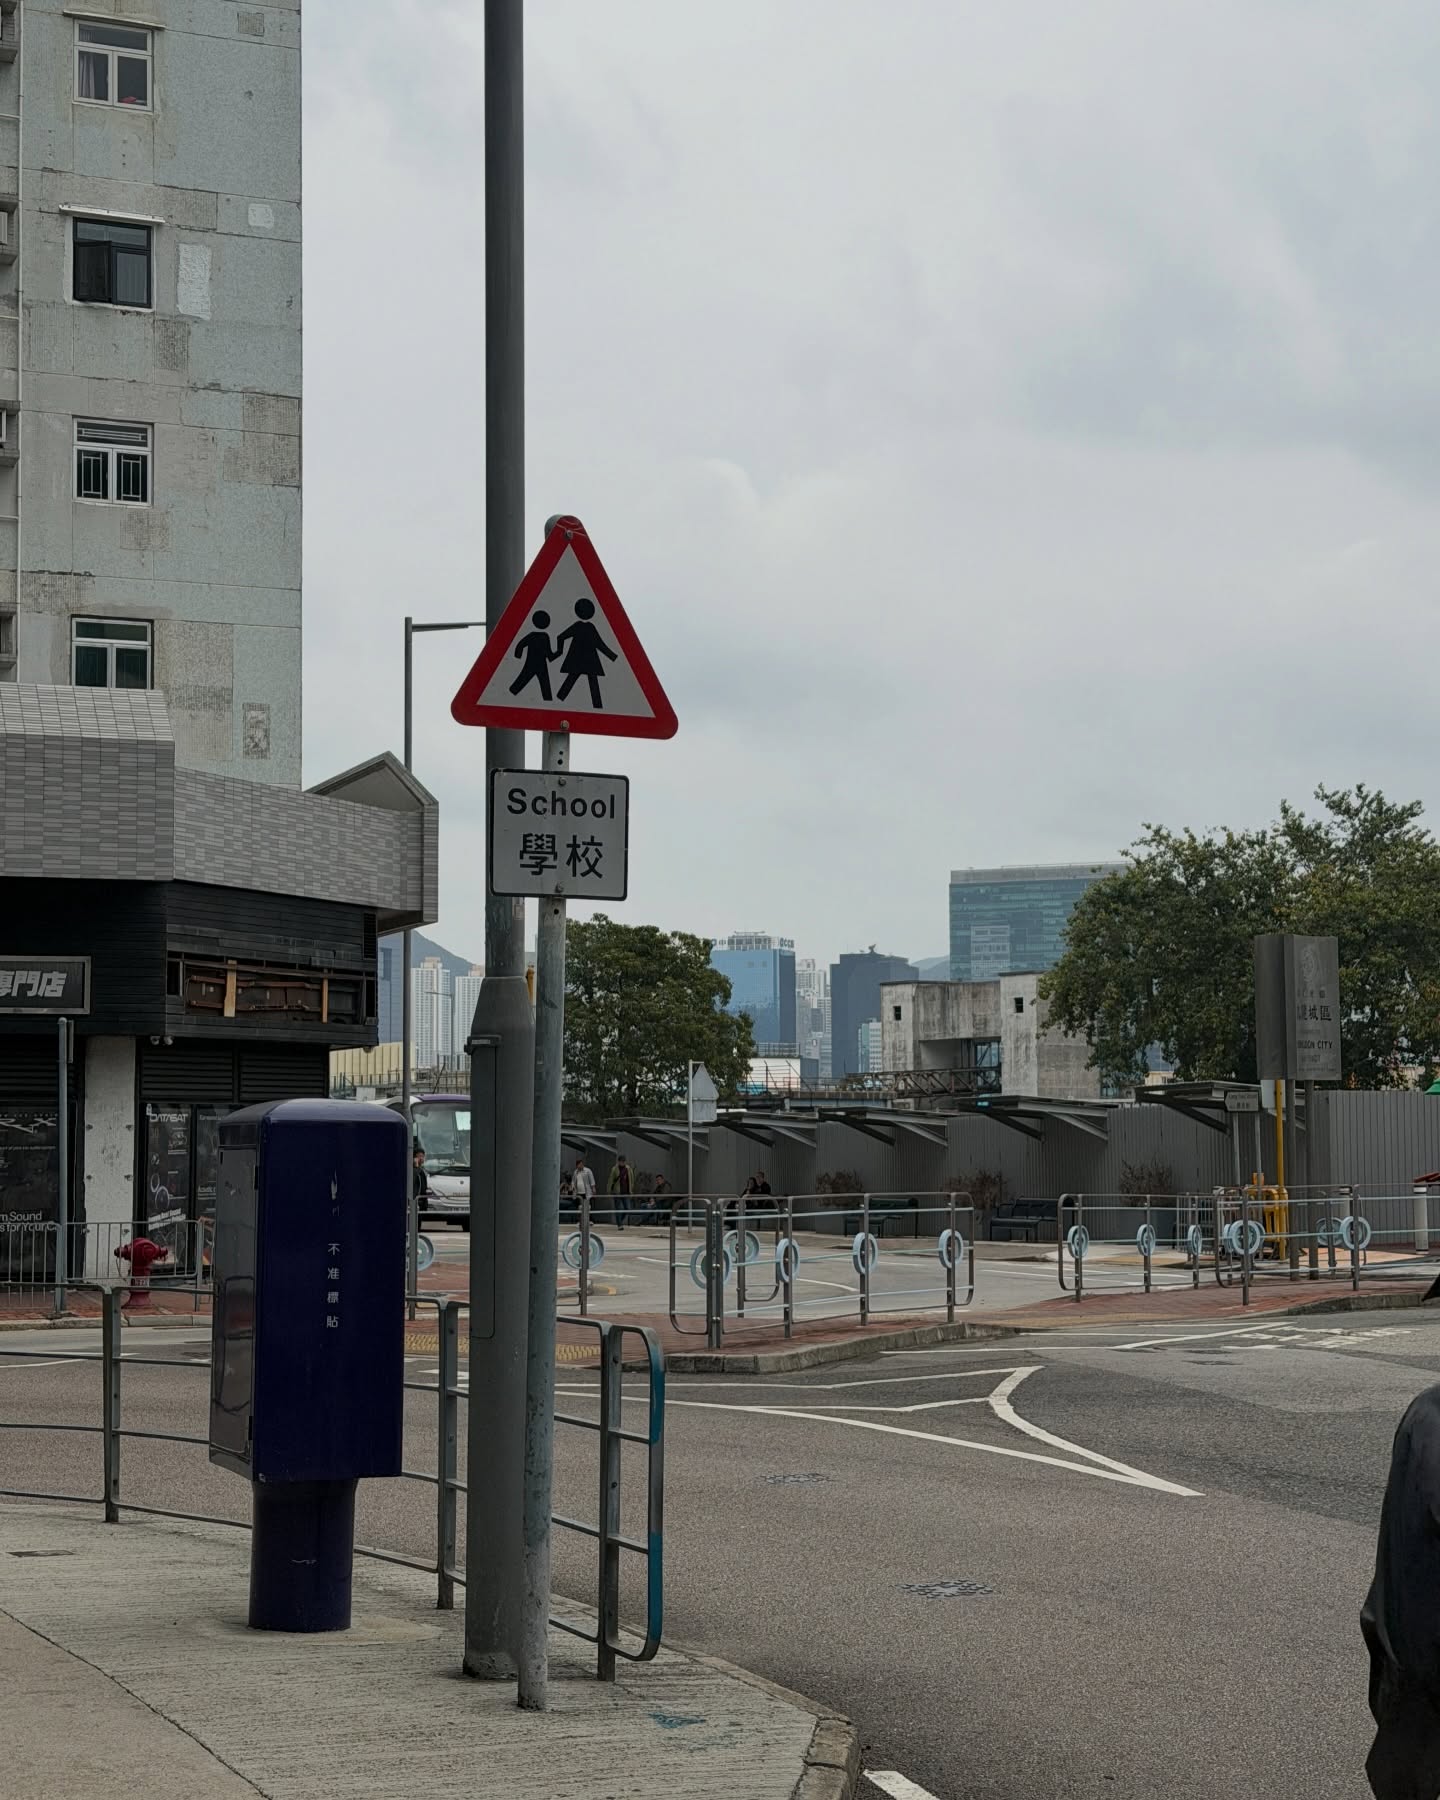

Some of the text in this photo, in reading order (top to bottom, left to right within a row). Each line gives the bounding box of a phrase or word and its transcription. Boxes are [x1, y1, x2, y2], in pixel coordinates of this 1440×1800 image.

[507, 788, 615, 819] School
[520, 832, 603, 879] 學校
[1317, 1039, 1332, 1049] CITY
[9, 1210, 42, 1222] Sound
[7, 1222, 20, 1232] for
[22, 1222, 45, 1232] Your
[326, 1243, 341, 1328] 不准標貼
